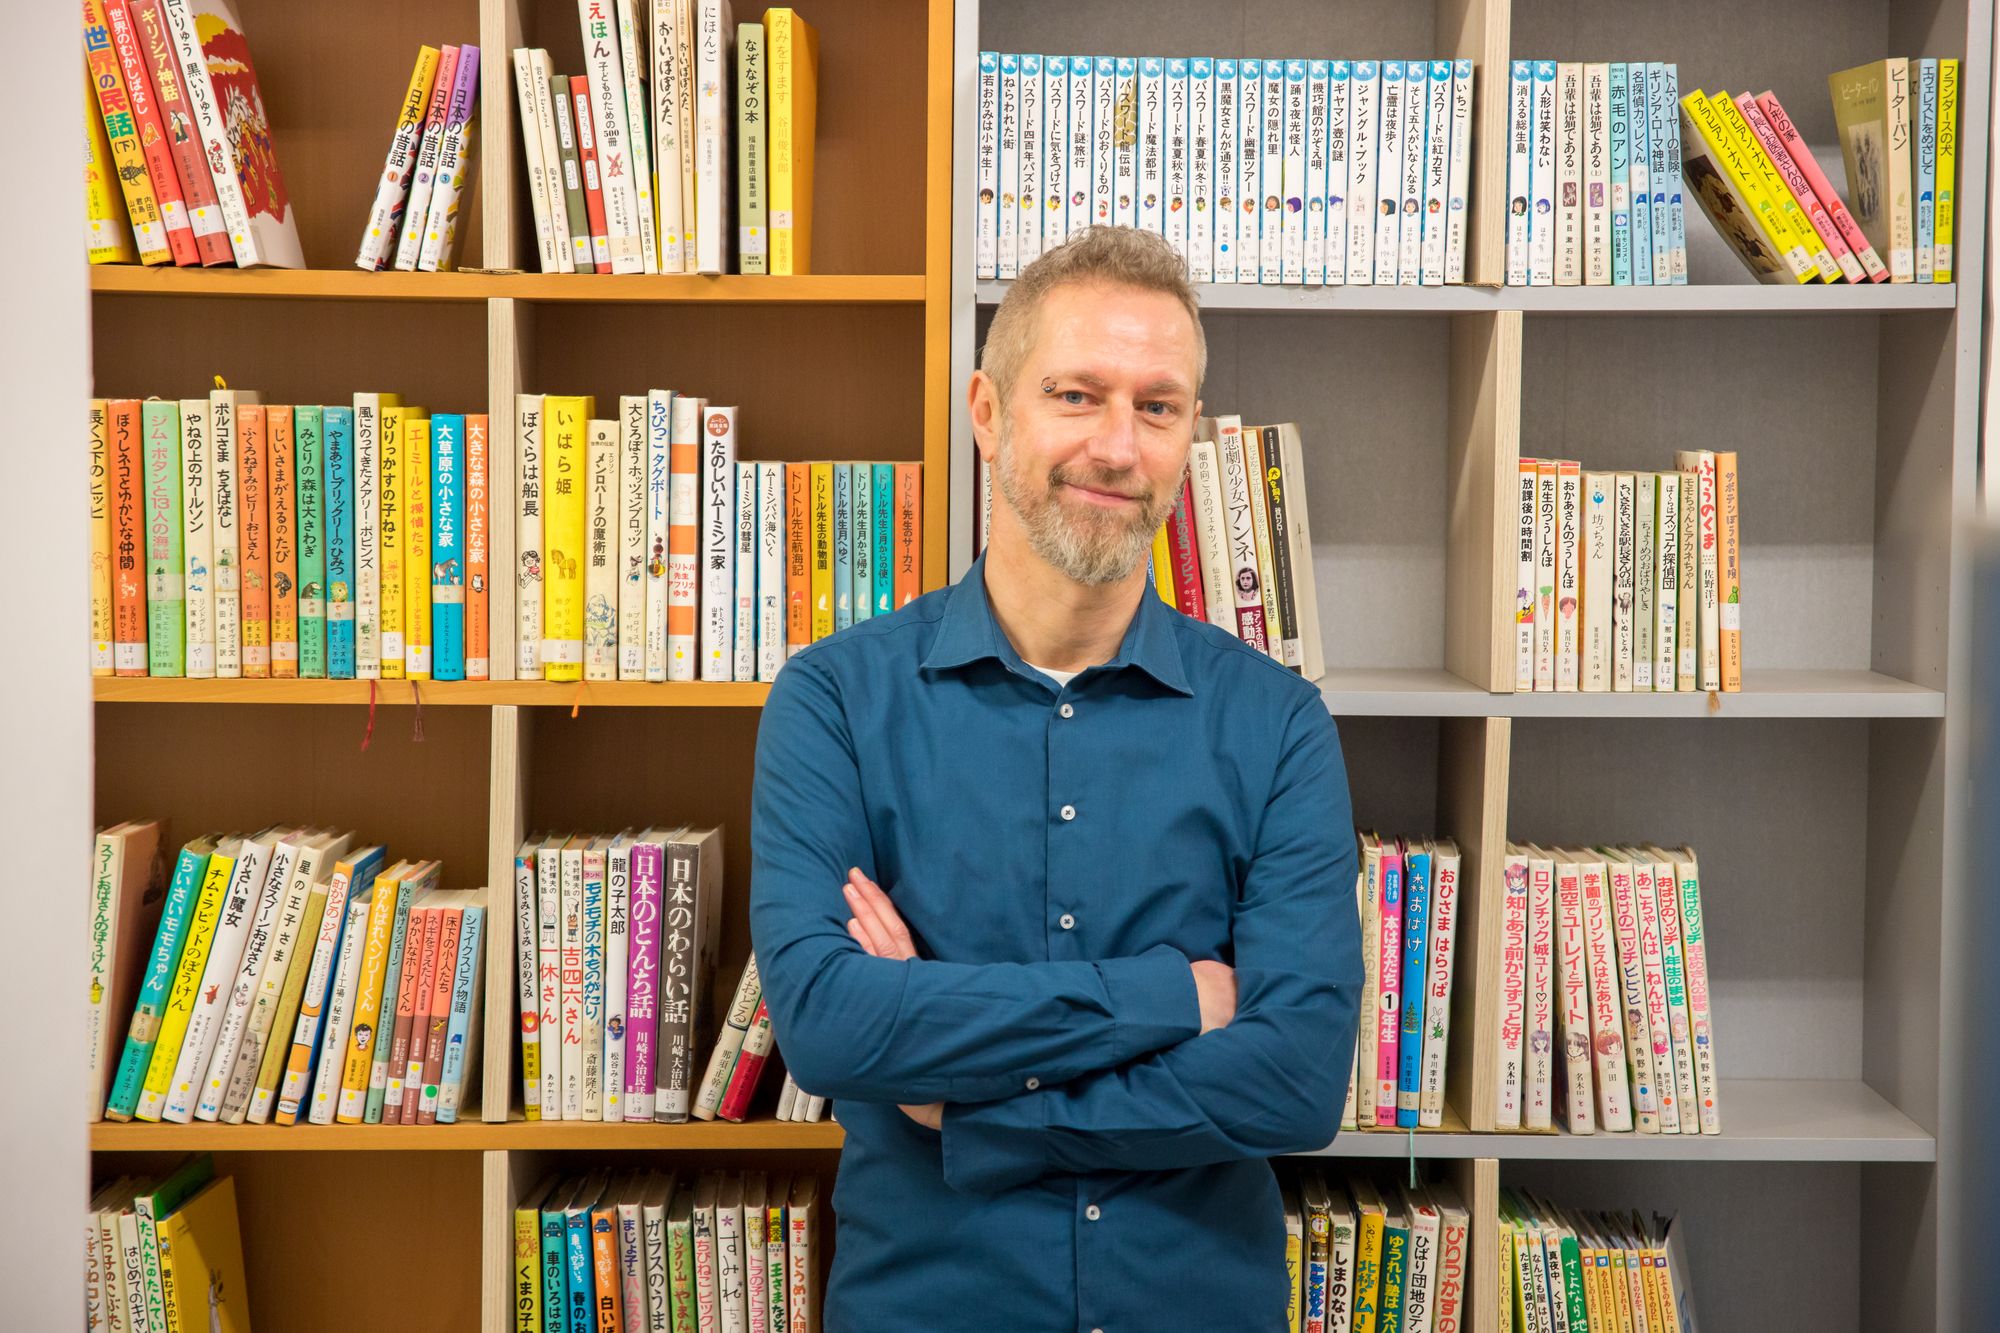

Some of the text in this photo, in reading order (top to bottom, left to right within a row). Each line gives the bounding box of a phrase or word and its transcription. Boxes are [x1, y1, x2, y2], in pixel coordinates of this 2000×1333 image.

[109, 8, 149, 116] 世界のむかしばなし
[141, 9, 180, 103] ギリシア神話
[589, 2, 610, 59] えほん
[659, 21, 675, 126] おーいぽぽんた
[704, 6, 717, 62] にほんご
[745, 39, 759, 123] なぞなぞの本
[775, 15, 789, 105] みみをすます
[84, 25, 135, 139] 世界の民話
[187, 63, 211, 127] 黒いりゅう
[390, 89, 423, 168] 日本の昔話
[419, 89, 447, 168] 日本の昔話
[441, 89, 467, 168] 日本の昔話
[981, 75, 995, 181] 若おかみは小学生！
[1002, 77, 1016, 150] ねらわれた街
[1074, 78, 1087, 168] パスワード謎旅行
[1119, 79, 1132, 177] パスワード龍伝説
[1145, 80, 1158, 180] パスワード魔法都市
[1267, 82, 1279, 155] 魔女の隠れ里
[1289, 84, 1301, 157] 踊る夜光怪人
[1311, 82, 1324, 170] 機巧館のかぞえ唄
[1332, 83, 1345, 162] ギヤマン壺の謎
[1385, 85, 1399, 153] 亡霊は夜歩く
[1455, 83, 1467, 118] いちご
[1515, 85, 1528, 154] 消える総生島
[1538, 84, 1551, 168] 人形は笑わない
[1563, 74, 1577, 168] 吾輩は猫である
[1590, 74, 1602, 168] 吾輩は猫である
[1611, 85, 1626, 170] 赤毛のアン
[1632, 71, 1646, 164] 名探偵カッレくん
[1649, 70, 1664, 185] ギリシア・ローマ神話 上
[1665, 71, 1681, 183] トム・ソーヤーの冒険 下
[1767, 98, 1798, 142] 人形の家
[1891, 67, 1908, 151] ピーター・パン
[1921, 66, 1935, 176] エヴェレストをめざして
[1940, 65, 1955, 157] フランダースの犬
[1023, 78, 1036, 193] パスワード四百年パズル
[1050, 78, 1063, 193] パスワードに気をつけて
[1097, 78, 1112, 194] パスワードのおくりもの
[1244, 81, 1257, 192] パスワード幽霊ツアー
[1355, 84, 1368, 184] ジャングル・ブック
[1406, 86, 1421, 194] そして五人がいなくなる
[1694, 97, 1751, 183] アラビアン・ナイト
[1717, 97, 1775, 182] アラビアン・ナイト
[89, 409, 105, 519] 長くつ下のピッピ
[117, 413, 135, 570] ぼうしネコとゆかいな仲間
[150, 415, 170, 560] ジム・ボタンと13人の海賊
[186, 414, 204, 533] やねの上のカールソン
[215, 403, 232, 528] ポルコさま ちえばなし
[243, 428, 260, 560] ふくろねずみのビリーおじさん
[273, 429, 290, 563] じいさまがえるのたび
[300, 428, 317, 557] みどりの森は大さわぎ
[328, 430, 346, 575] やまあらしプリックリーのひみつ
[358, 406, 374, 569] 風にのってきたメアリー・ポピンズ
[382, 415, 397, 548] びりっかすの子ねこ
[409, 429, 424, 557] エーミールと探偵たち
[437, 424, 454, 547] 大草原の小さな家
[469, 423, 485, 563] 大きな森の小さな家
[522, 412, 539, 517] ぼくらは船長
[555, 410, 573, 496] いばら姫
[628, 403, 644, 547] 大どろぼうホッツェンプロッツ
[650, 401, 667, 520] ちびっこ タグボート
[1224, 435, 1255, 562] 悲劇の少女アンネ
[710, 440, 726, 570] たのしいムーミン一家
[740, 470, 753, 553] ムーミン谷の彗星
[764, 468, 777, 557] ムーミンパパ海へいく
[791, 472, 803, 577] ドリトル先生航海記
[816, 474, 828, 570] ドリトル先生の動物園
[837, 472, 848, 565] ドリトル先生月へゆく
[856, 472, 868, 578] ドリトル先生月から帰る
[878, 473, 889, 587] ドリトル先生と月からの使い
[903, 473, 913, 574] ドリトル先生のサーカス
[1521, 478, 1534, 562] 放課後の時間割
[1541, 480, 1554, 567] 先生のつうしんぼ
[1563, 481, 1575, 589] おかあさんのつうしんぼ
[1592, 514, 1605, 560] 坊っちゃん
[1619, 484, 1632, 588] ちいさなちいさな駅長さんの話
[1662, 485, 1677, 590] ぼくらはズッコケ探偵団
[1683, 478, 1694, 589] モモちゃんとアカネちゃん
[1700, 460, 1715, 550] ふつうのくま
[1725, 472, 1738, 579] サボテンぼうやの冒険
[1704, 569, 1715, 608] 佐野洋子
[91, 844, 114, 973] スプーンおばさんのぼうけん
[147, 856, 193, 990] ちいさいモモちゃん
[225, 853, 257, 928] 小さい魔女
[241, 853, 289, 977] 小さなスプーンおばさん
[273, 860, 312, 962] 星の王子さま
[320, 879, 347, 943] 町かどのジム
[549, 857, 557, 894] 寺村輝夫の
[572, 860, 580, 897] 寺村輝夫の
[610, 857, 626, 935] 龍の子太郎
[1613, 874, 1638, 965] おばけのコッチ
[1682, 880, 1701, 944] おばけのソッチ
[172, 869, 224, 1011] チム・ラビットのぼうけん
[360, 886, 392, 1012] がんばれヘンリーくん
[400, 916, 422, 1012] ゆかいなホーマーくん
[419, 916, 440, 988] ネギをうえた人
[438, 917, 458, 994] 床下の小人たち
[454, 915, 477, 1014] シェイクスピア物語
[519, 876, 534, 999] くしゃみくしゃみ 天のめぐみ
[584, 882, 602, 1020] モチモチの木ものがたり
[629, 855, 657, 1019] 日本のとんち話
[664, 858, 694, 1024] 日本のわらい話
[1432, 869, 1455, 998] おひさま はらっぱ
[1502, 895, 1526, 1050] 知りあう前からずっと好き
[1560, 876, 1585, 1026] 星空でユーレイとデート
[1584, 873, 1613, 1027] 学園のプリンセスはだあれ？
[1637, 873, 1664, 1026] あこちゃんは 一ねんせい
[1657, 877, 1684, 1006] おばけのソッチ 1年生のまき
[540, 948, 559, 1025] 一休さん
[562, 946, 581, 1045] 吉四六さん
[610, 1052, 620, 1095] 松谷みよ子
[1677, 1048, 1689, 1093] 角野栄子
[1700, 1051, 1711, 1096] 角野栄子
[102, 1228, 122, 1330] 三つ子のこぶた
[140, 1221, 164, 1330] たんたのたんてい
[646, 1218, 665, 1330] ガラスのうま
[1439, 1226, 1466, 1333] びりっかすの
